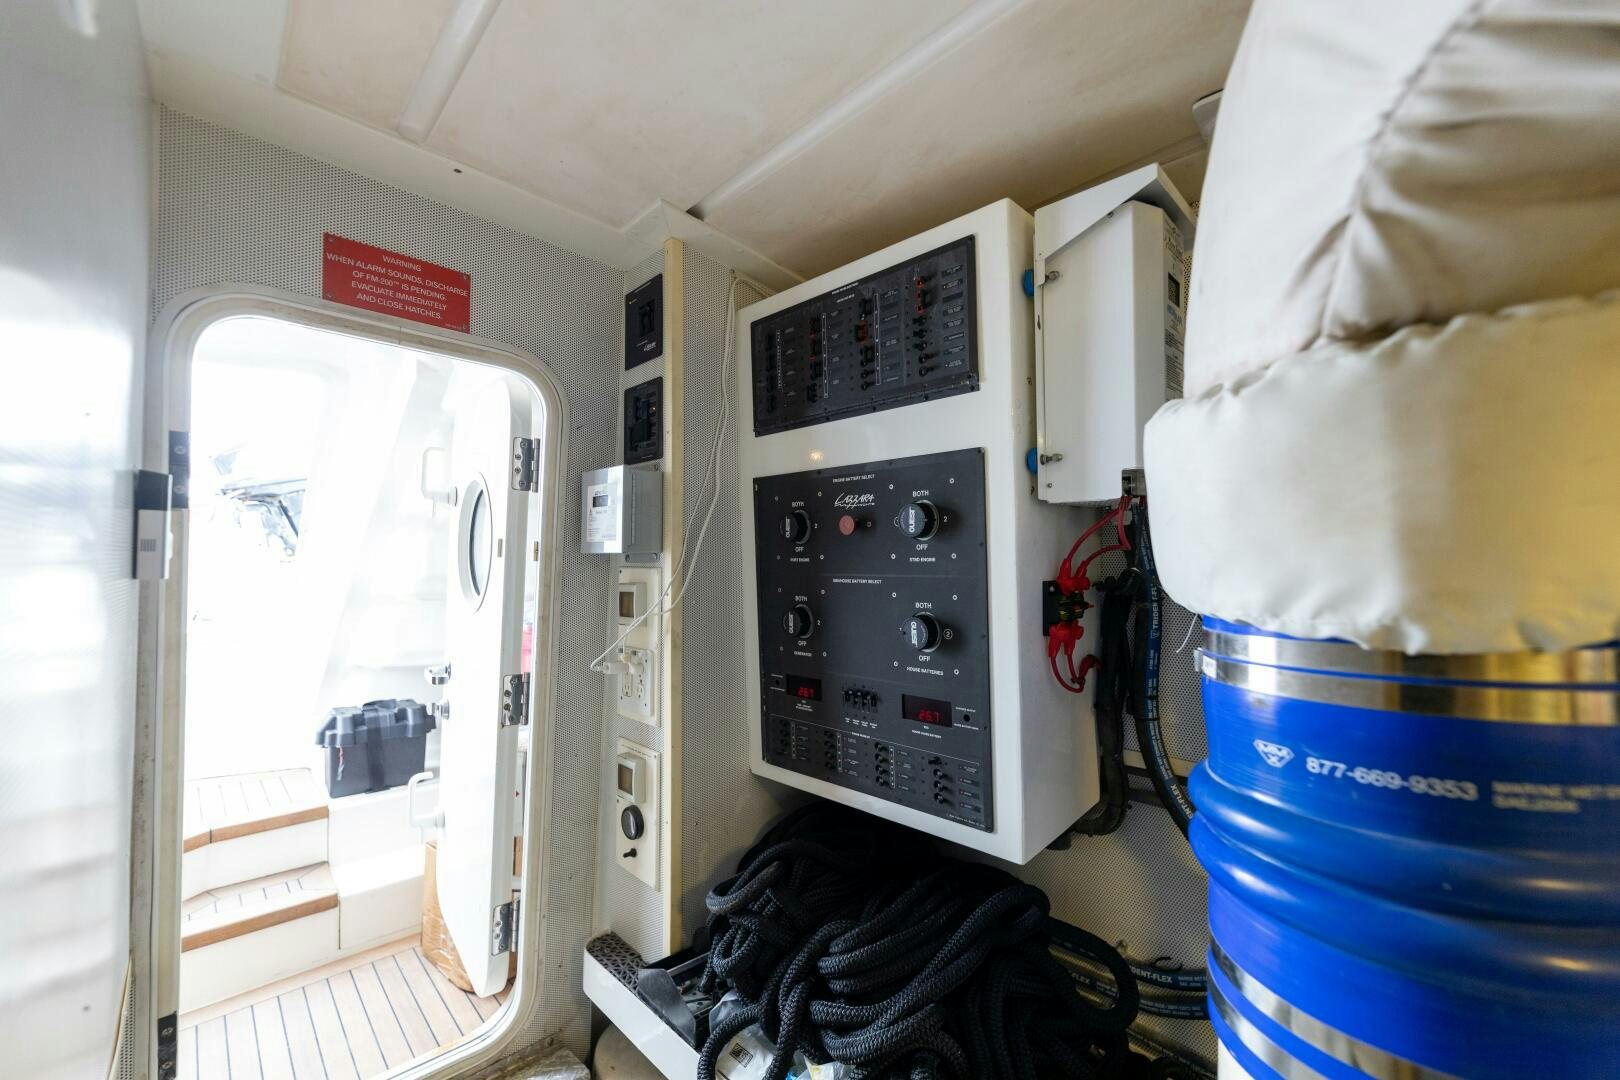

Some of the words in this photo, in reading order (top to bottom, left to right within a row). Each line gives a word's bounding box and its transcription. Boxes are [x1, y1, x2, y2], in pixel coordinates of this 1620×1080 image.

[326, 252, 354, 266] WHEN
[356, 260, 386, 274] ALARM
[388, 270, 424, 286] SOUNDS,
[425, 279, 469, 297] DISCHARGE
[352, 270, 365, 279] OF
[382, 254, 422, 272] WARNING
[352, 280, 394, 298] EVACUATE
[396, 292, 448, 311] IMMEDIATELY
[356, 292, 376, 304] AND
[377, 298, 404, 310] CLOSE
[1306, 756, 1478, 802] 877-669-9353
